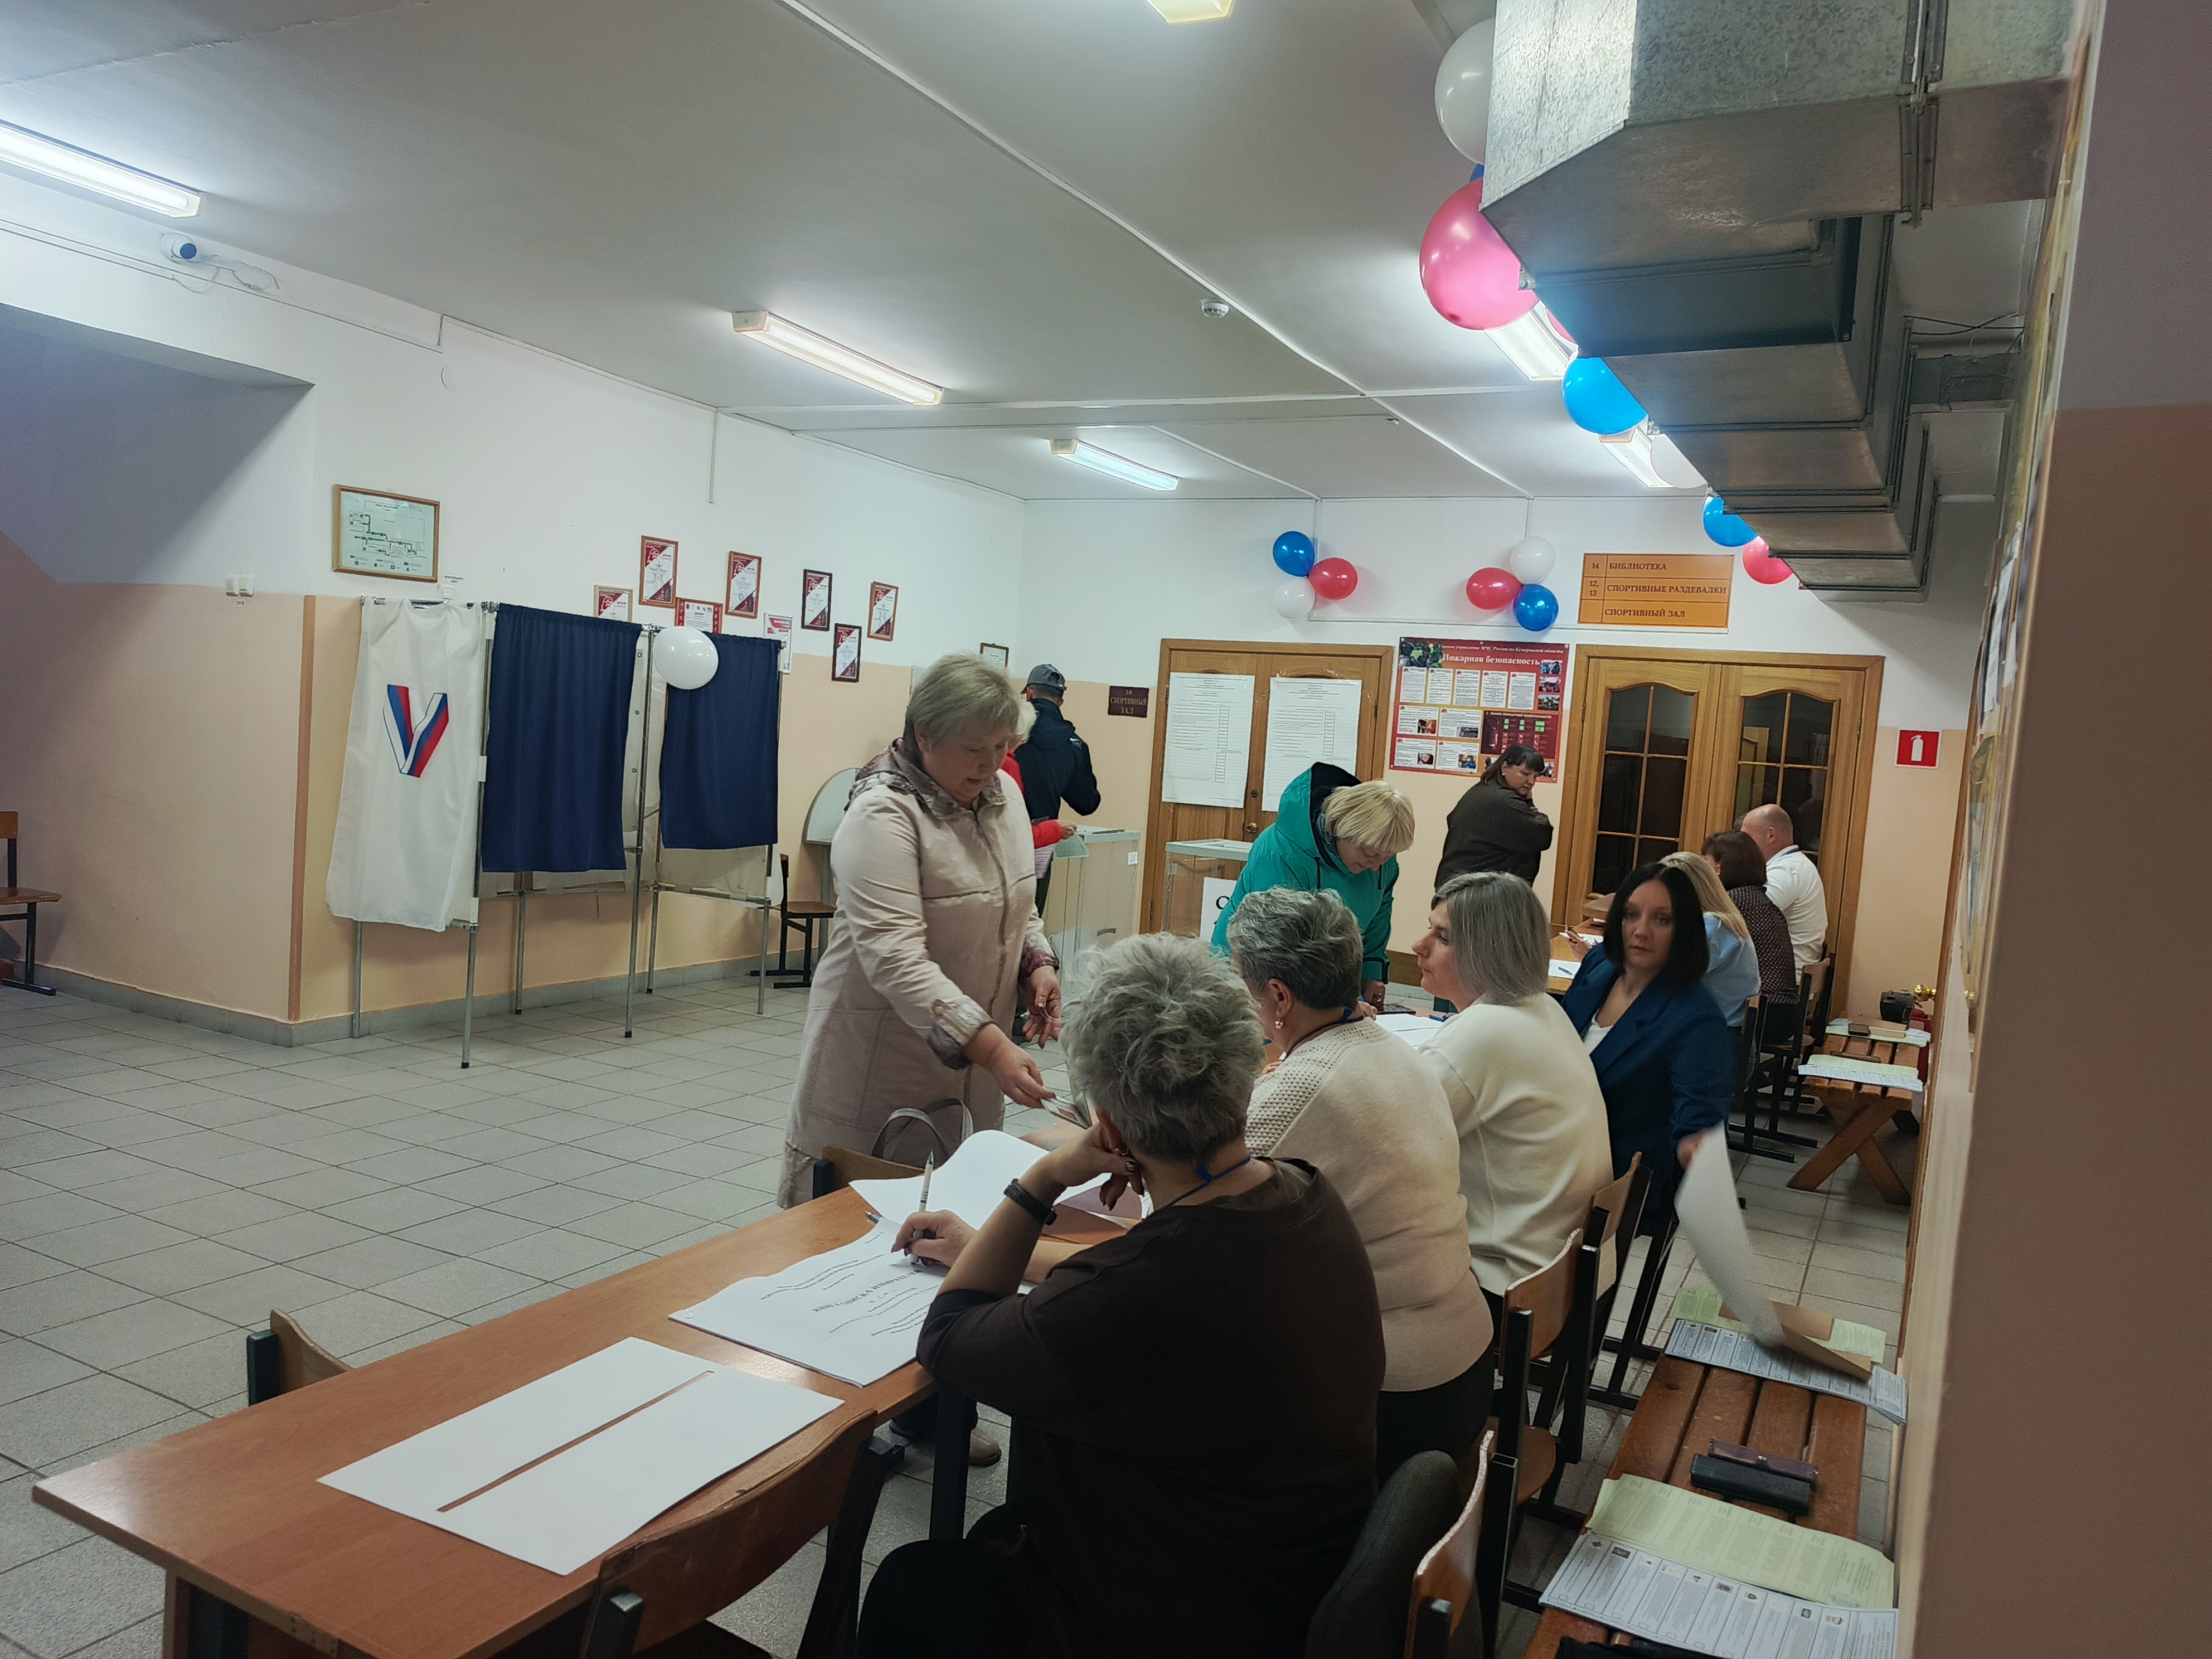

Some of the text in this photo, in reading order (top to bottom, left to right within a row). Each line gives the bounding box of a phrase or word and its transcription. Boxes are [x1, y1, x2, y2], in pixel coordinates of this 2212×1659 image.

[1604, 608, 1666, 617] СПОРТИВНЫЙ
[1442, 653, 1540, 665] Пожарная безопасность
